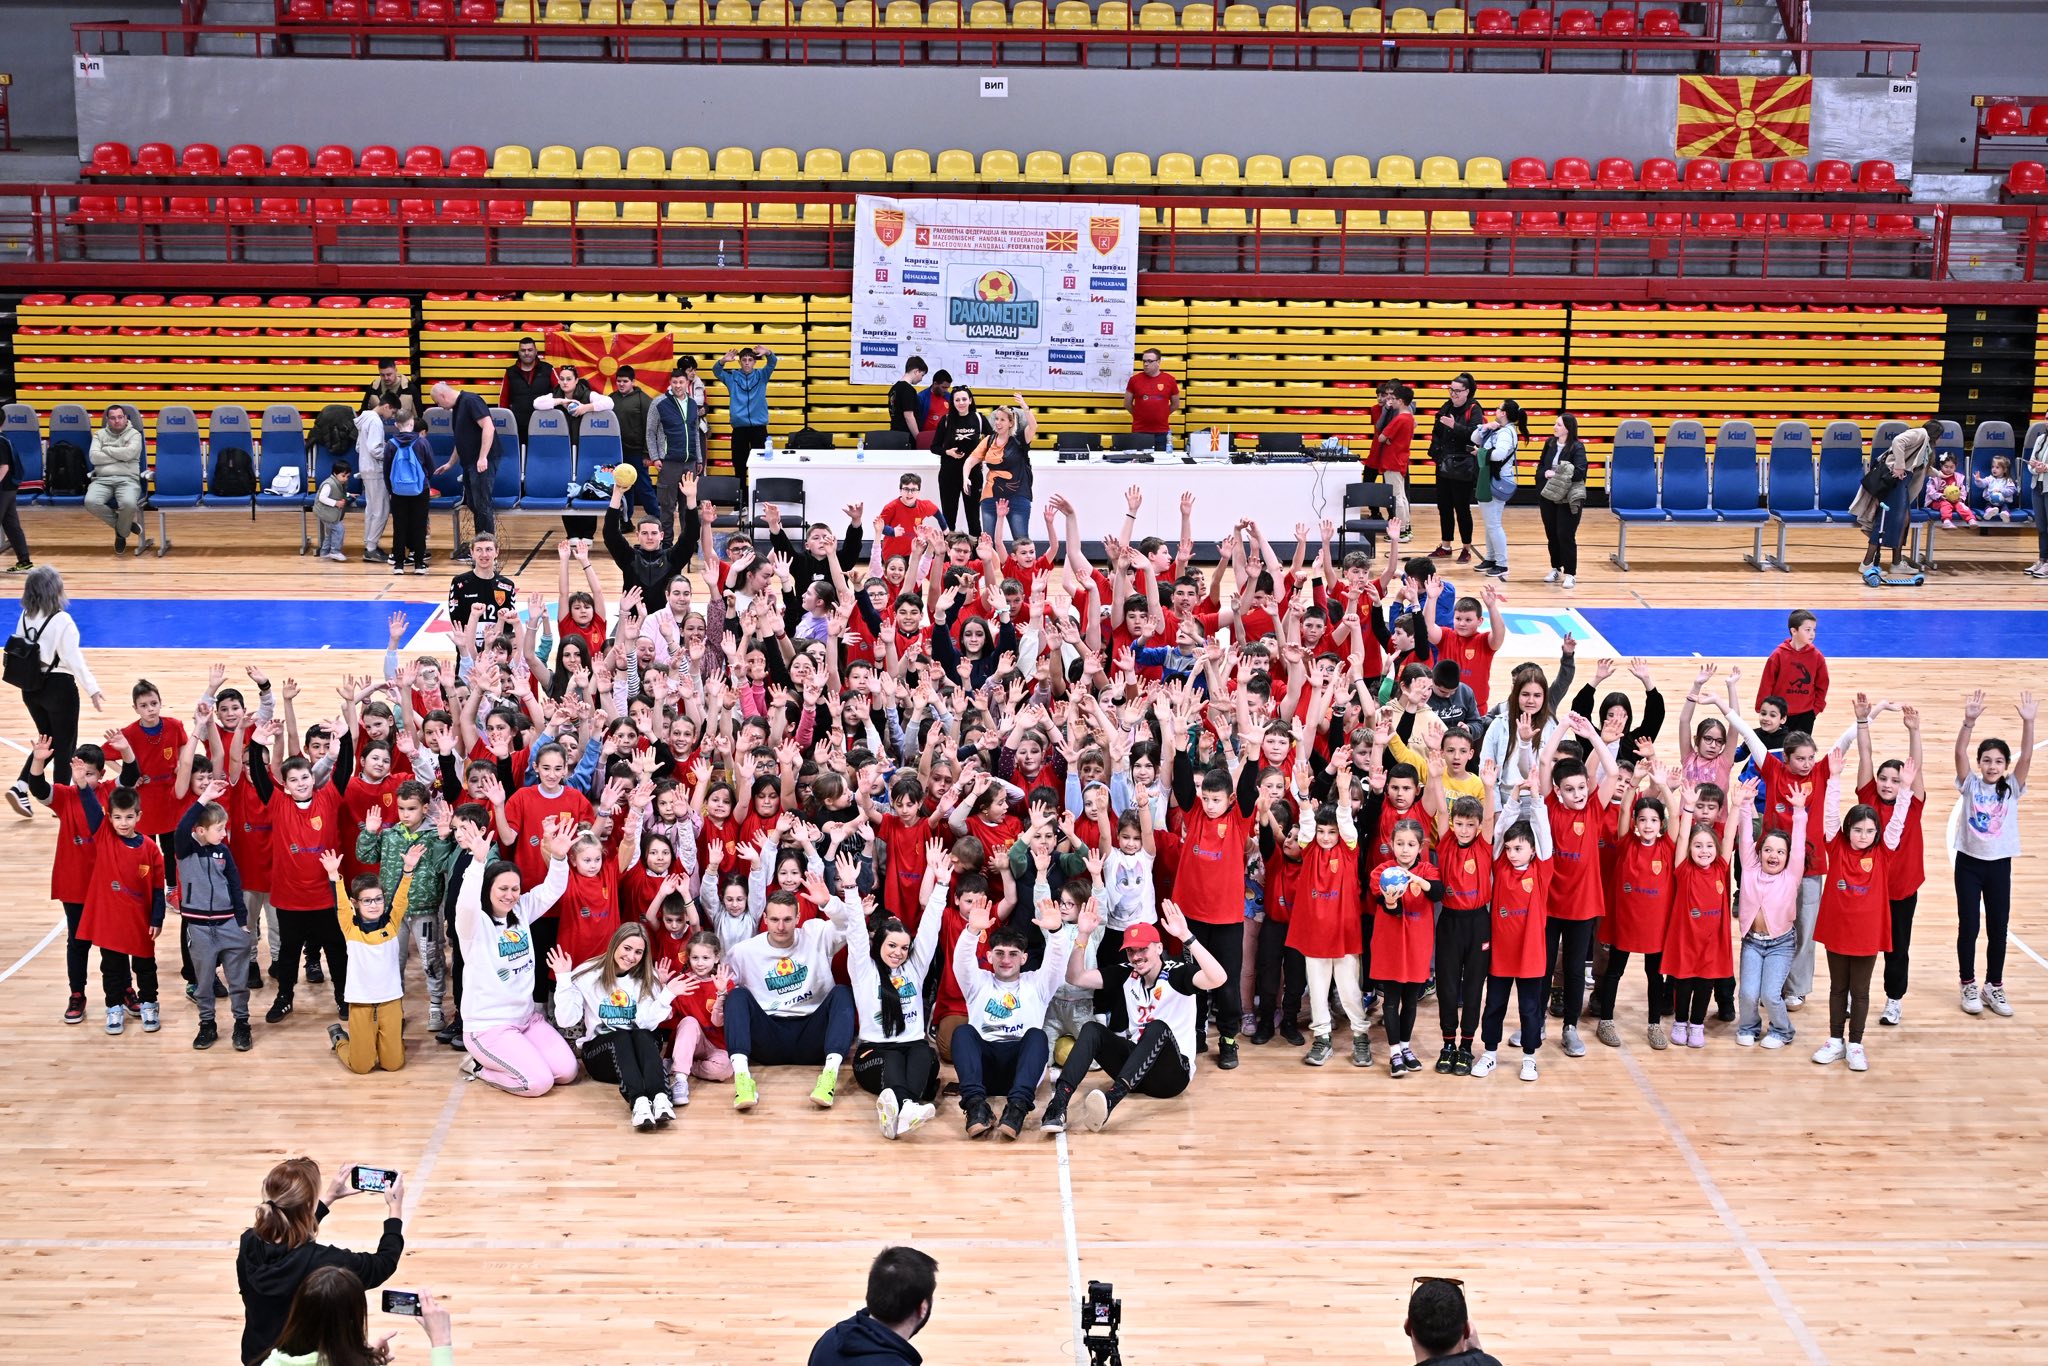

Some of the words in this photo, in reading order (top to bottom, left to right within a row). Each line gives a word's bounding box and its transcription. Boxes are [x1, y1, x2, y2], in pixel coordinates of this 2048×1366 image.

[984, 81, 1004, 90] ВИП
[1893, 85, 1912, 94] ВИП
[933, 227, 964, 235] РАКОМЕТНА
[932, 234, 975, 242] MAZEDONISCHE
[932, 241, 971, 249] MACEDONIAN
[974, 242, 1004, 250] HANDBALL
[910, 273, 937, 281] HALKBANK
[952, 299, 1037, 326] РАКОМЕТЕН
[1978, 311, 1983, 319] 7
[968, 324, 1017, 338] КАРАВАН
[1975, 338, 1981, 346] 6
[868, 345, 896, 353] HALKBANK
[1974, 365, 1979, 373] 5
[482, 604, 495, 620] 12
[784, 990, 812, 1006] TITAN
[902, 1010, 917, 1020] TAN
